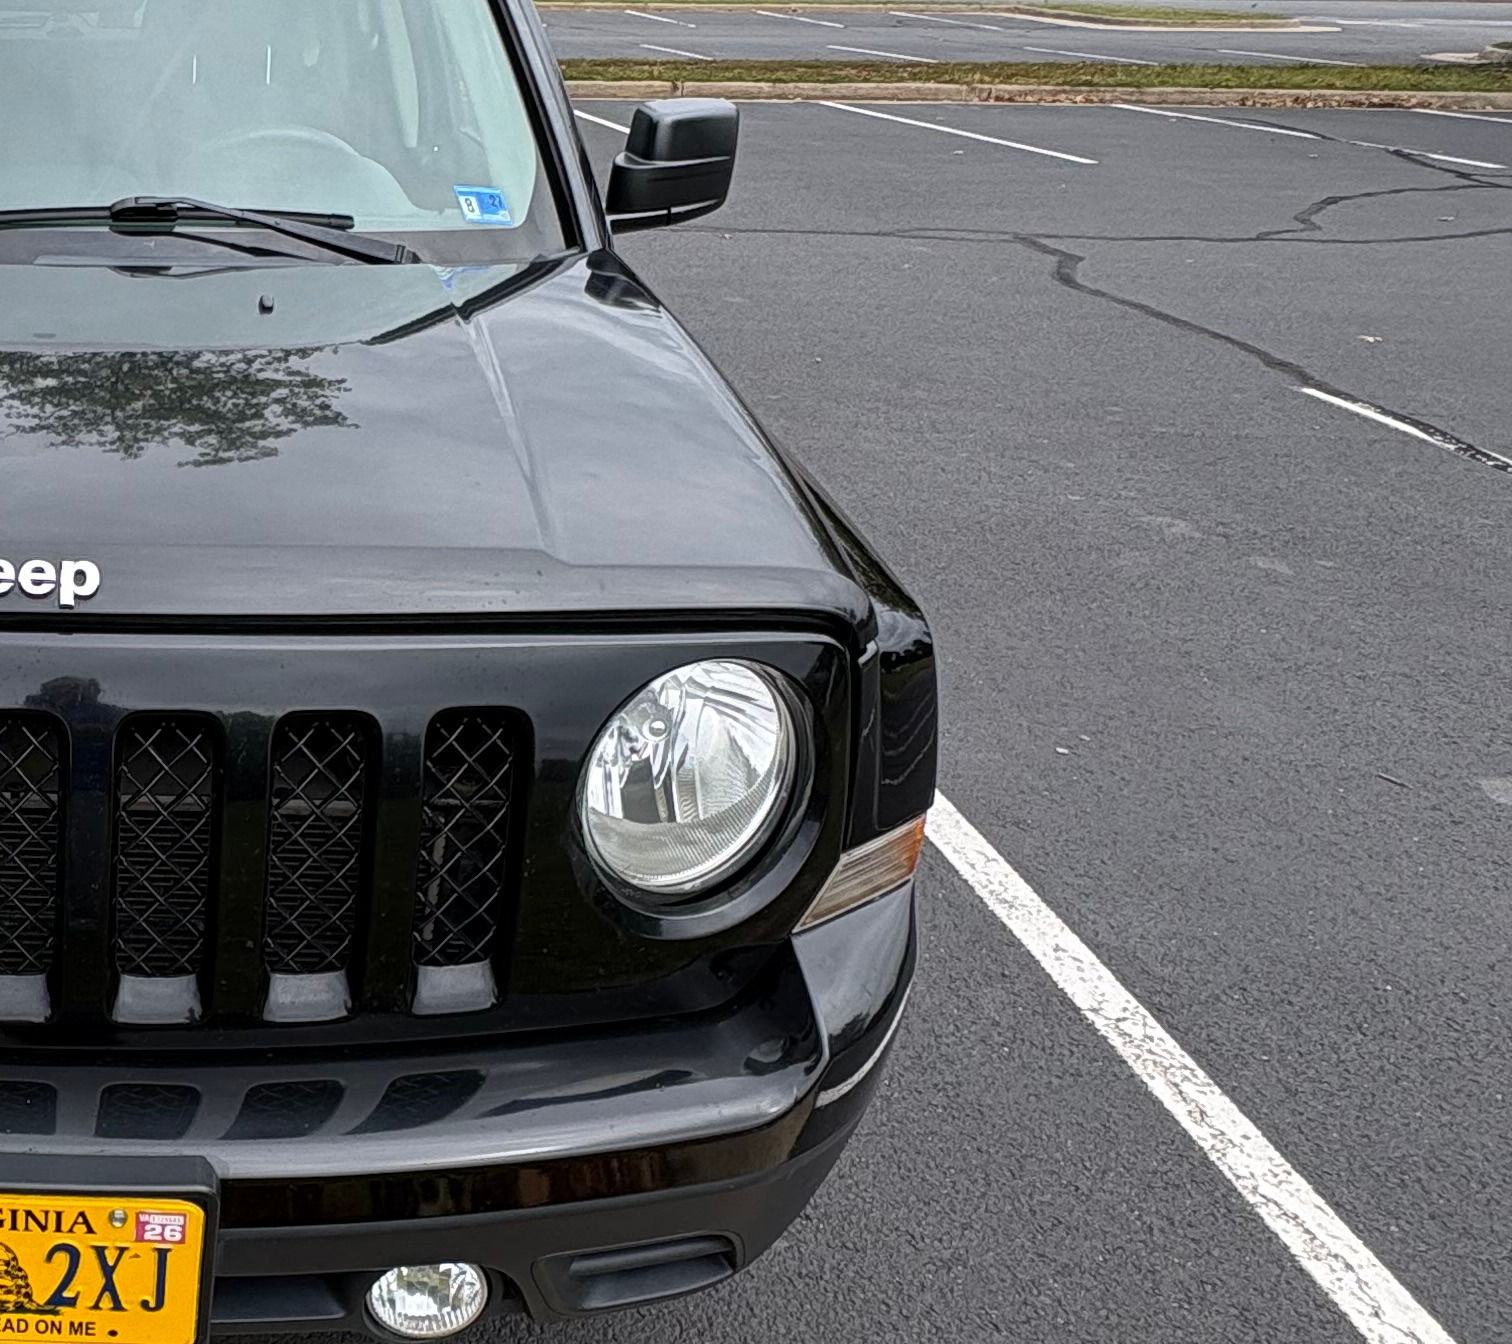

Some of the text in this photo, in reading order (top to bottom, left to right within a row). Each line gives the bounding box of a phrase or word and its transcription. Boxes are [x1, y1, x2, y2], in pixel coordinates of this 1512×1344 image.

[465, 197, 475, 213] 8
[143, 1223, 182, 1242] 26
[43, 1242, 173, 1312] 2XJ
[35, 1319, 63, 1335] ON
[68, 1321, 96, 1336] ME
